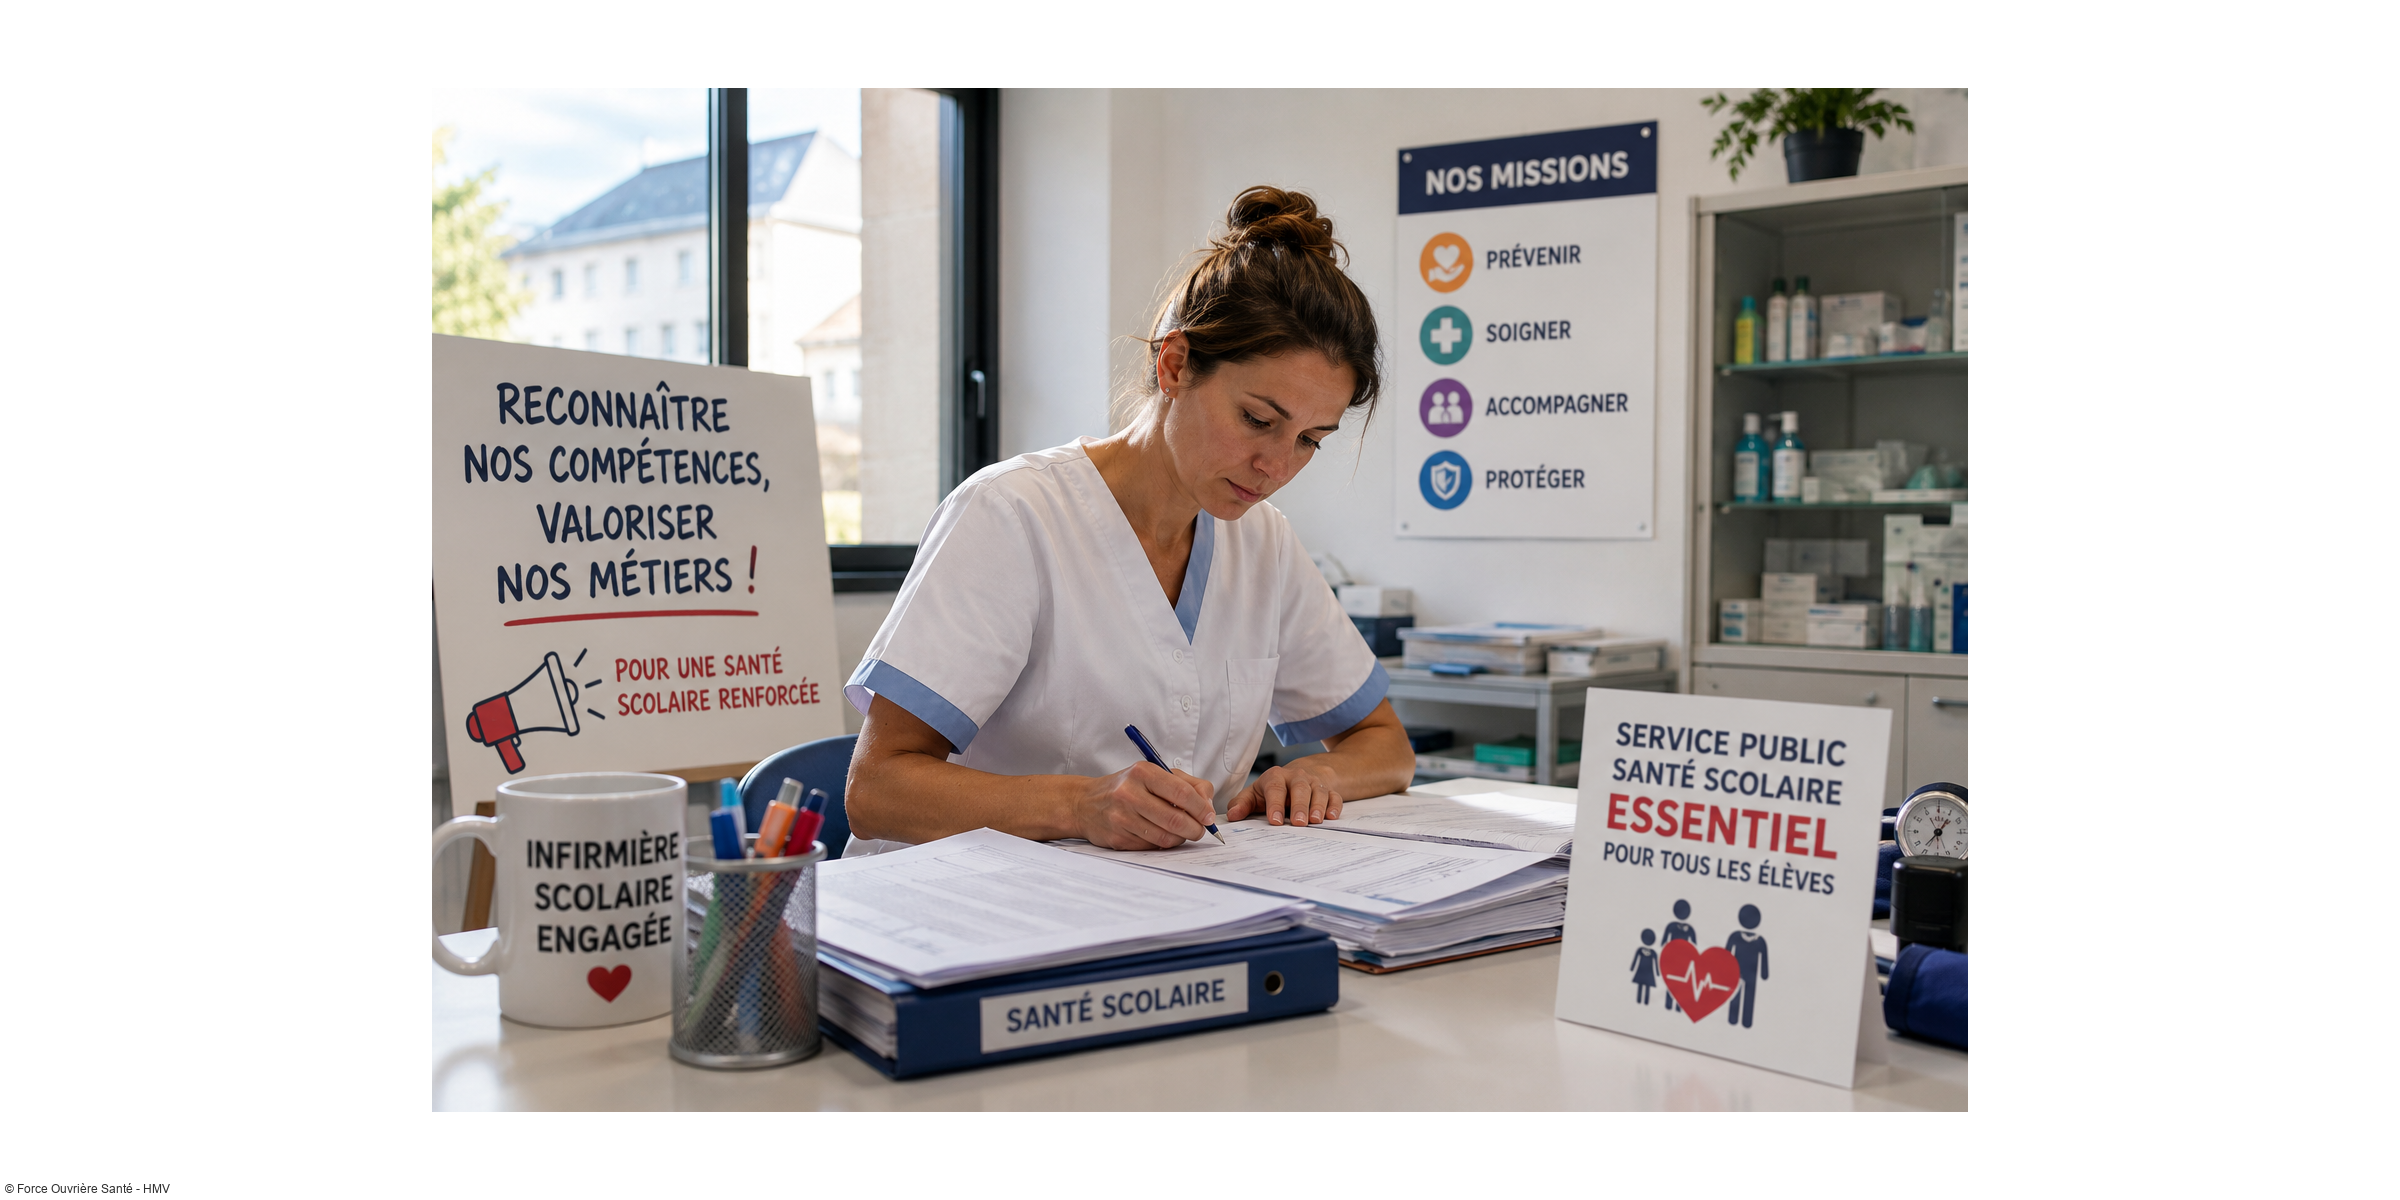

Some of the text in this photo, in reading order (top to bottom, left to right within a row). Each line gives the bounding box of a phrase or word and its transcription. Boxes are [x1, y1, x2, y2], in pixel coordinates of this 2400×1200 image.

[1426, 151, 1629, 195] NOS MISSIONS
[1487, 243, 1580, 269] PRÉVENIR
[1487, 320, 1571, 343] SOIGNER
[497, 381, 730, 433] RECONNAÎTRE
[1486, 393, 1628, 416] ACCOMPAGNER
[464, 437, 769, 492] NOS COMPÉTENCES,
[1486, 464, 1584, 489] PROTÉGER
[536, 502, 717, 544] VALORISER
[498, 545, 757, 604] NOS MÉTIERS !
[615, 646, 783, 682] POUR UNE SANTÉ
[618, 677, 820, 716] SCOLAIRE RENFORCÉE
[1616, 722, 1846, 766] SERVICE PUBLIC
[1613, 758, 1843, 806] SANTÉ SCOLAIRE
[1607, 793, 1838, 859] ESSENTIEL
[528, 830, 679, 870] INFIRMIÈRE
[1604, 842, 1836, 895] POUR TOUS LES ÉLÈVES
[535, 875, 673, 911] SCOLAIRE
[538, 912, 671, 953] ENGAGÉE
[1006, 979, 1225, 1033] SANTÉ SCOLAIRE
